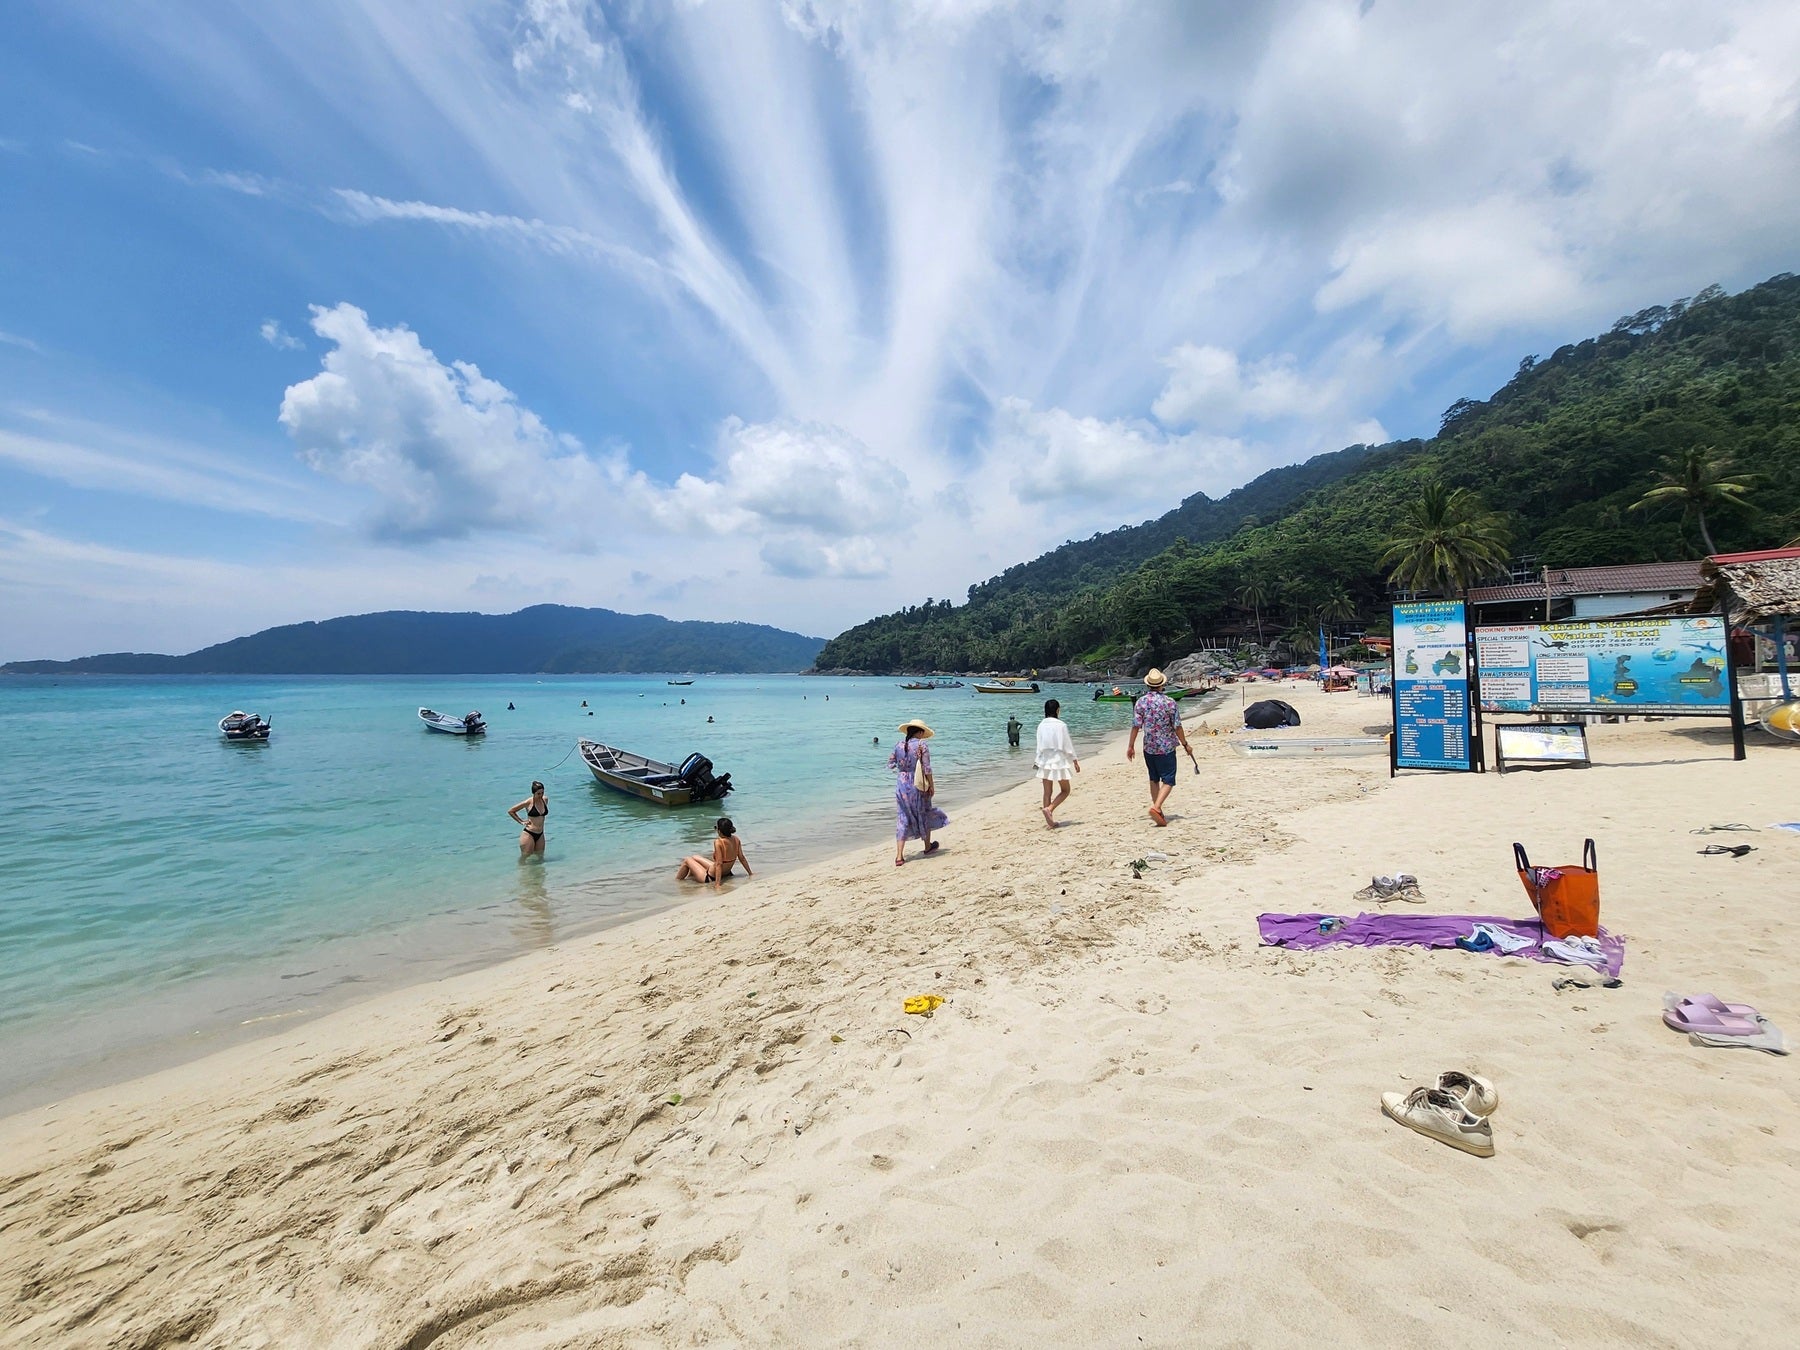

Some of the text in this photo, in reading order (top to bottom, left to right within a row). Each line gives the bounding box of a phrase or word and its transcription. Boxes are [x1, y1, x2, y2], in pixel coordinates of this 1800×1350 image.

[1425, 599, 1464, 607] STATION
[1596, 619, 1672, 629] Station
[1549, 629, 1660, 641] Water Taxi
